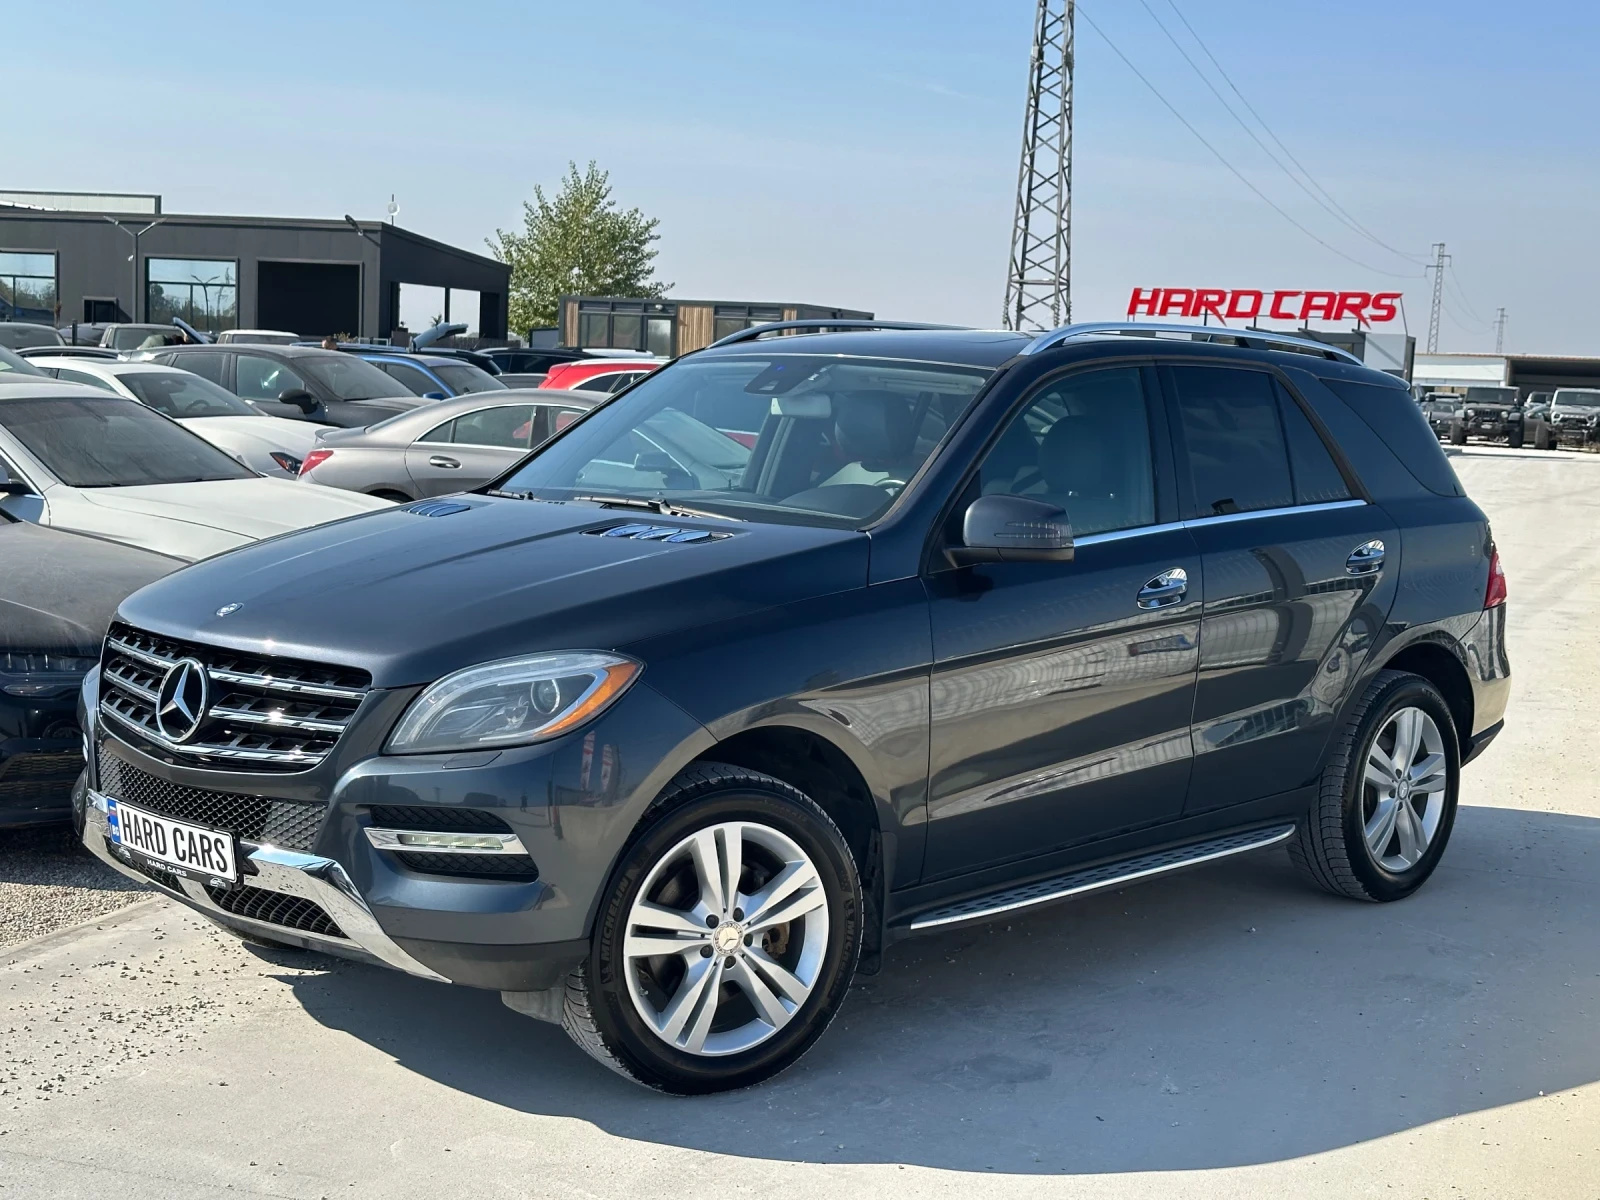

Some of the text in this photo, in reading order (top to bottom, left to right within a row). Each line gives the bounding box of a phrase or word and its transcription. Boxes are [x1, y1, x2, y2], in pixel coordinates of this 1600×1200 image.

[1127, 288, 1403, 329] HARD CARS
[120, 809, 228, 873] HARD CARS
[147, 859, 187, 877] HARD CARS
[601, 875, 632, 961] MICHELIN
